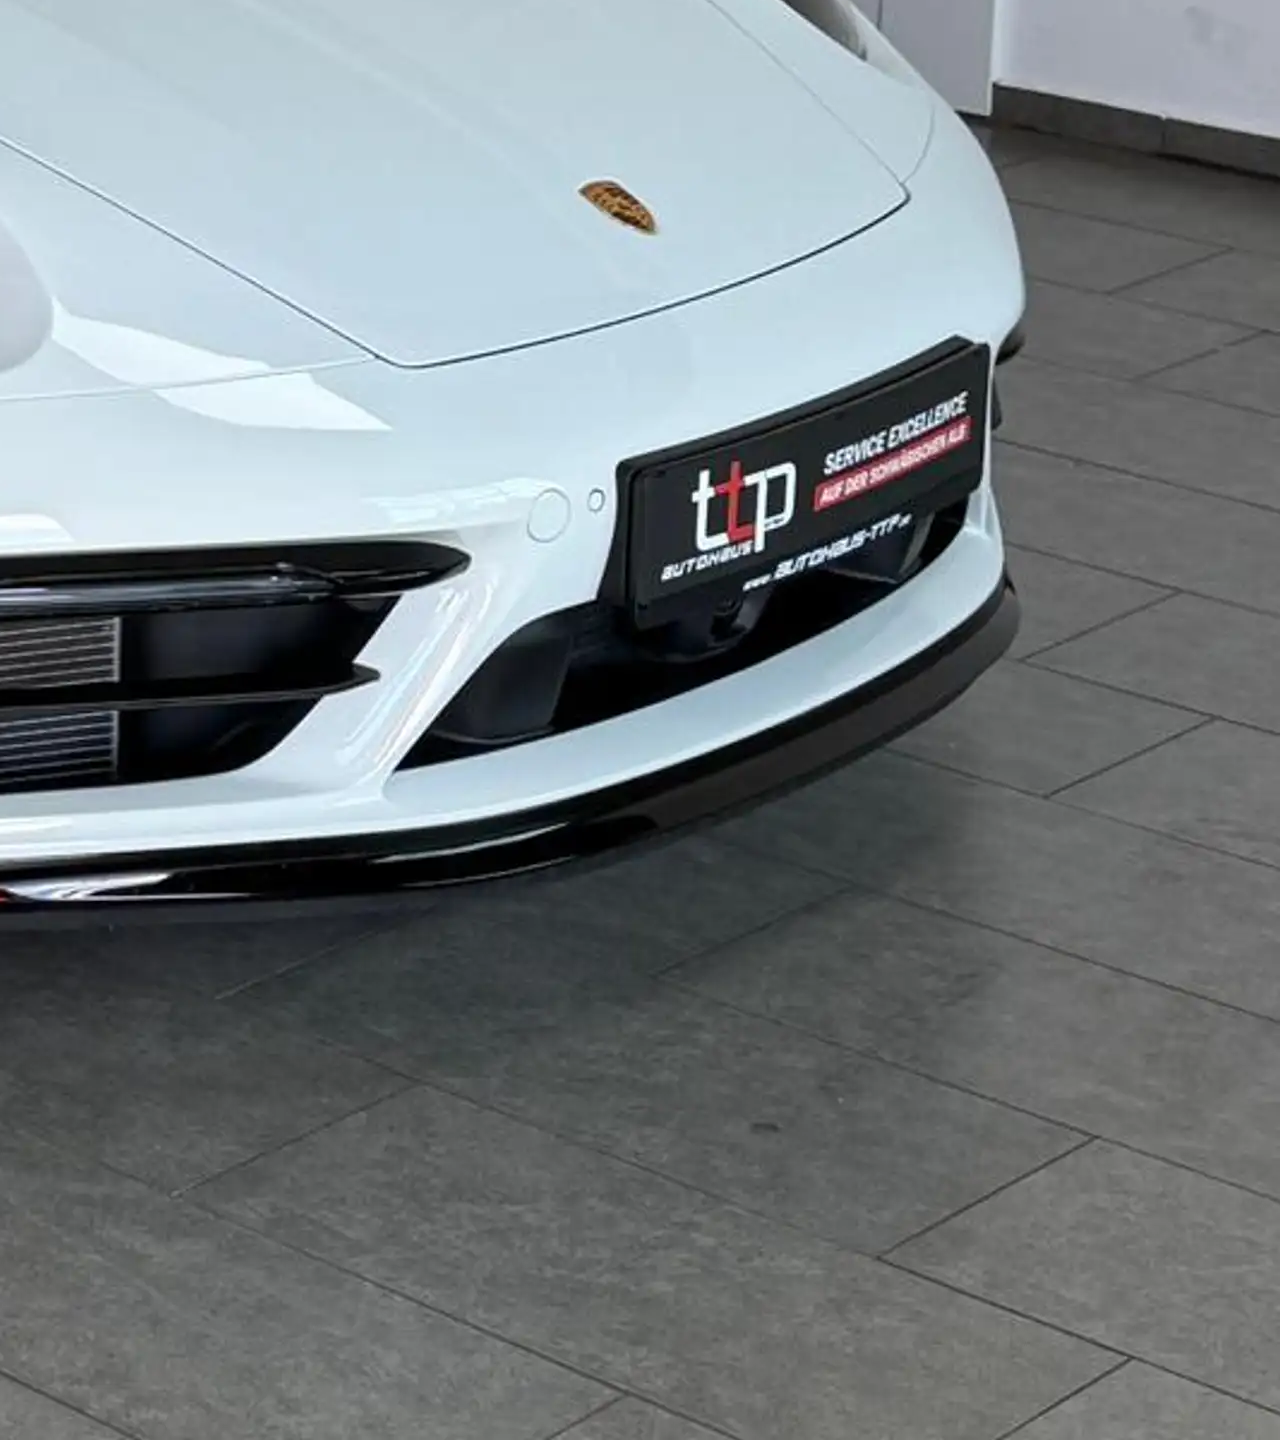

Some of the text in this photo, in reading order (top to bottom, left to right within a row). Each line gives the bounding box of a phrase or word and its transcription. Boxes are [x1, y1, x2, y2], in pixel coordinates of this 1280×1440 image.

[823, 390, 969, 476] SERVICE EXCELLENCE
[661, 540, 754, 581] AUTOHAUS
